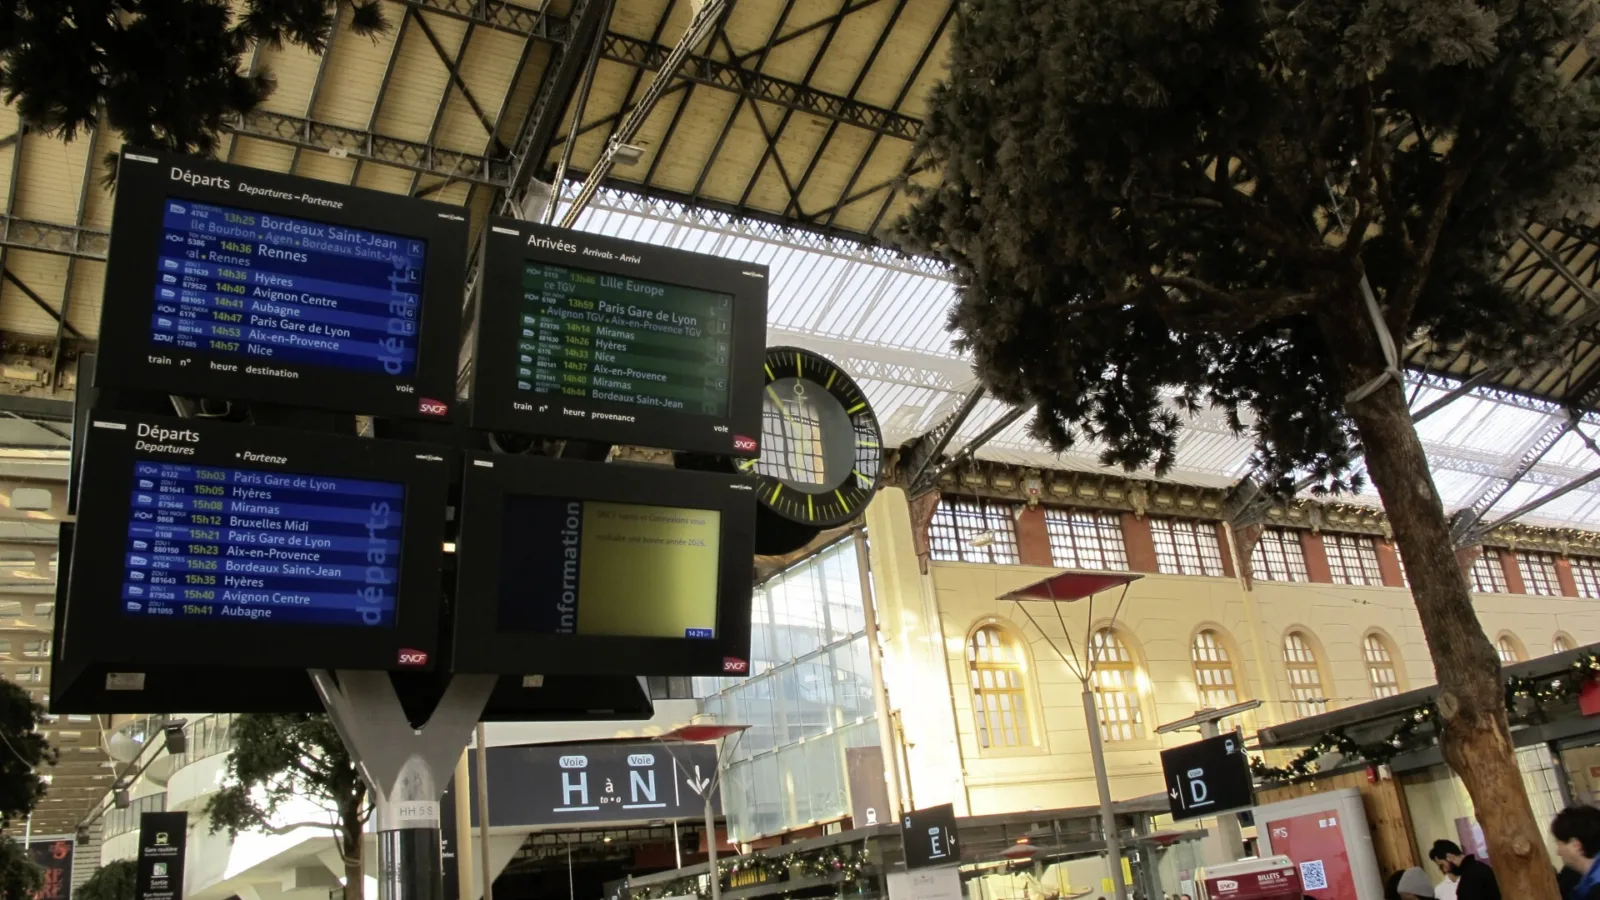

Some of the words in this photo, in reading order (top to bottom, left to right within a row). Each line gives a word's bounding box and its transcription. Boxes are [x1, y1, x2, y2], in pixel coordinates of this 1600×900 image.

[170, 167, 231, 190] Départs
[238, 182, 293, 200] Departures
[301, 193, 344, 209] Partenze
[208, 221, 256, 240] Bourbon
[265, 232, 293, 245] Agen
[302, 237, 352, 255] Bordeaux
[223, 213, 256, 226] 13h25
[260, 216, 324, 238] Bordeaux
[328, 227, 397, 250] Saint-Jean
[221, 240, 257, 254] 14h36
[258, 244, 308, 263] Rennes
[527, 234, 577, 253] Arrivées
[582, 247, 613, 260] Arrivals
[620, 253, 642, 264] Arrivi
[209, 251, 251, 267] Rennes
[217, 268, 247, 280] 14h36
[255, 272, 293, 287] Hyères
[600, 275, 624, 289] Lille
[626, 279, 665, 297] Europe
[216, 282, 246, 295] 14h40
[252, 286, 298, 302] Avignon
[301, 293, 338, 308] Centre
[557, 281, 576, 293] TGV
[214, 297, 244, 309] 14h41
[251, 301, 301, 317] Aubagne
[568, 298, 595, 310] 13h59
[598, 300, 626, 315] Paris
[628, 305, 653, 319] Gare
[655, 310, 669, 322] de
[671, 312, 698, 326] Lyon
[212, 311, 243, 323] 14h47
[250, 314, 278, 328] Paris
[280, 319, 306, 332] Gare
[308, 323, 322, 334] de
[325, 325, 351, 338] Lyon
[546, 306, 584, 320] Avignon
[586, 312, 606, 323] TGV
[611, 316, 683, 334] Aix-en-Provence
[684, 326, 702, 338] TGV
[211, 325, 241, 338] 14h53
[248, 329, 340, 351] Aix-en-Provence
[566, 323, 591, 333] 14h14
[596, 326, 635, 340] Miramas
[209, 340, 240, 352] 14h57
[247, 343, 273, 356] Nice
[565, 336, 590, 346] 14h26
[595, 338, 627, 352] Hyères
[564, 348, 589, 359] 14h33
[595, 351, 616, 363] Nice
[148, 354, 172, 365] train
[210, 361, 238, 372] heure
[245, 365, 300, 379] destination
[563, 361, 587, 371] 14h37
[593, 364, 668, 382] Aix-en-Provence
[396, 384, 415, 394] voie
[593, 376, 632, 390] Miramas
[419, 402, 447, 414] SNCF
[592, 389, 634, 404] Bordeaux
[636, 395, 684, 409] Saint-Jean
[513, 402, 533, 411] train
[563, 407, 586, 417] heure
[591, 411, 636, 423] provenance
[137, 423, 200, 442] Départs
[713, 424, 729, 433] voie
[135, 440, 195, 455] Departures
[734, 440, 756, 449] SNCF
[243, 451, 288, 465] Partenze
[161, 471, 179, 479] 6122
[195, 469, 226, 481] 15h03
[234, 471, 262, 484] Paris
[264, 474, 290, 487] Gare
[293, 478, 307, 488] de
[310, 480, 336, 491] Lyon
[194, 485, 225, 496] 15h05
[232, 486, 272, 500] Hyères
[193, 499, 223, 510] 15h08
[230, 502, 280, 515] Miramas
[191, 514, 221, 525] 15h12
[229, 516, 282, 530] Bruxelles
[284, 520, 309, 532] Midi
[690, 518, 706, 526] vous
[189, 530, 220, 540] 15h21
[228, 531, 256, 543] Paris
[258, 533, 285, 545] Gare
[287, 536, 302, 546] de
[304, 538, 331, 549] Lyon
[666, 538, 687, 546] année
[188, 544, 219, 555] 15h23
[226, 546, 321, 562] Aix-en-Provence
[187, 559, 218, 570] 15h26
[225, 561, 280, 574] Bordeaux
[282, 563, 342, 578] Saint-Jean
[356, 501, 392, 626] départs
[556, 502, 580, 634] information
[185, 574, 216, 585] 15h35
[224, 576, 265, 589] Hyères
[184, 589, 215, 600] 15h40
[222, 591, 270, 605] Avignon
[272, 593, 311, 605] Centre
[182, 604, 213, 615] 15h41
[221, 605, 273, 620] Aubagne
[399, 654, 427, 663] SNCF
[723, 662, 746, 670] SNCF
[563, 757, 585, 767] Voie
[631, 756, 651, 766] Voie
[561, 771, 589, 805] H
[605, 778, 615, 793] à
[629, 769, 657, 803] N
[1190, 779, 1208, 803] D
[600, 796, 609, 804] to
[400, 807, 416, 817] HH
[931, 835, 942, 855] E
[1257, 872, 1280, 882] BILLETS
